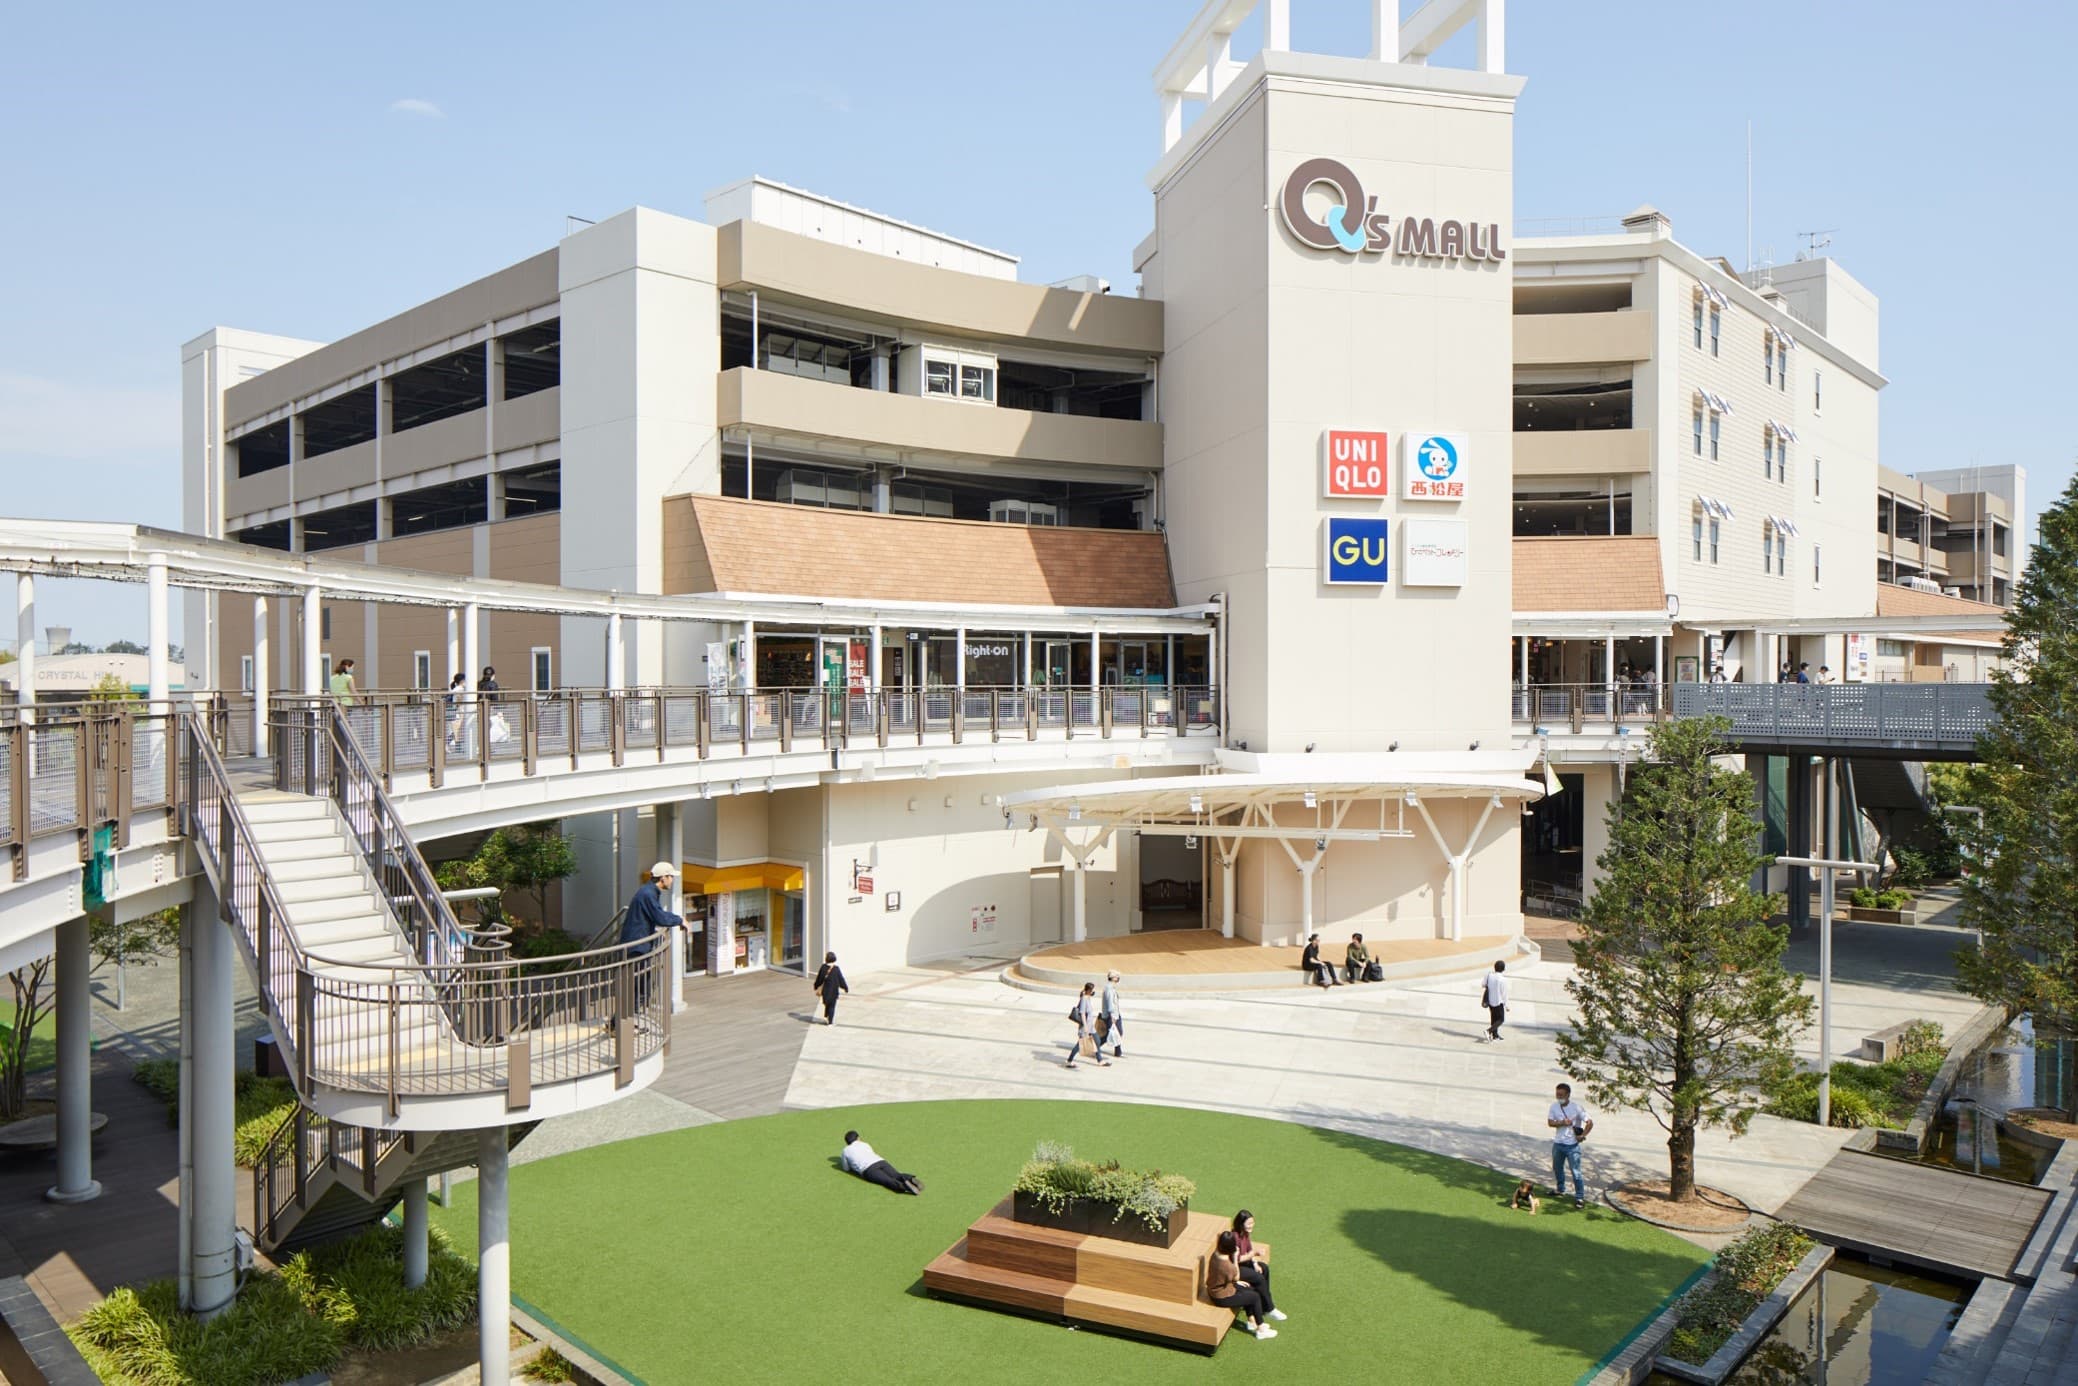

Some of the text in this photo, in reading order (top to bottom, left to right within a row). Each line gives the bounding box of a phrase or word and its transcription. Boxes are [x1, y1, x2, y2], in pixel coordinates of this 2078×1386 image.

[1401, 216, 1506, 260] MALL
[1335, 438, 1377, 462] UNI
[1335, 465, 1382, 492] QLO
[1411, 481, 1464, 497] 西松屋
[1332, 535, 1386, 566] GU
[38, 671, 88, 680] CRYSTAL
